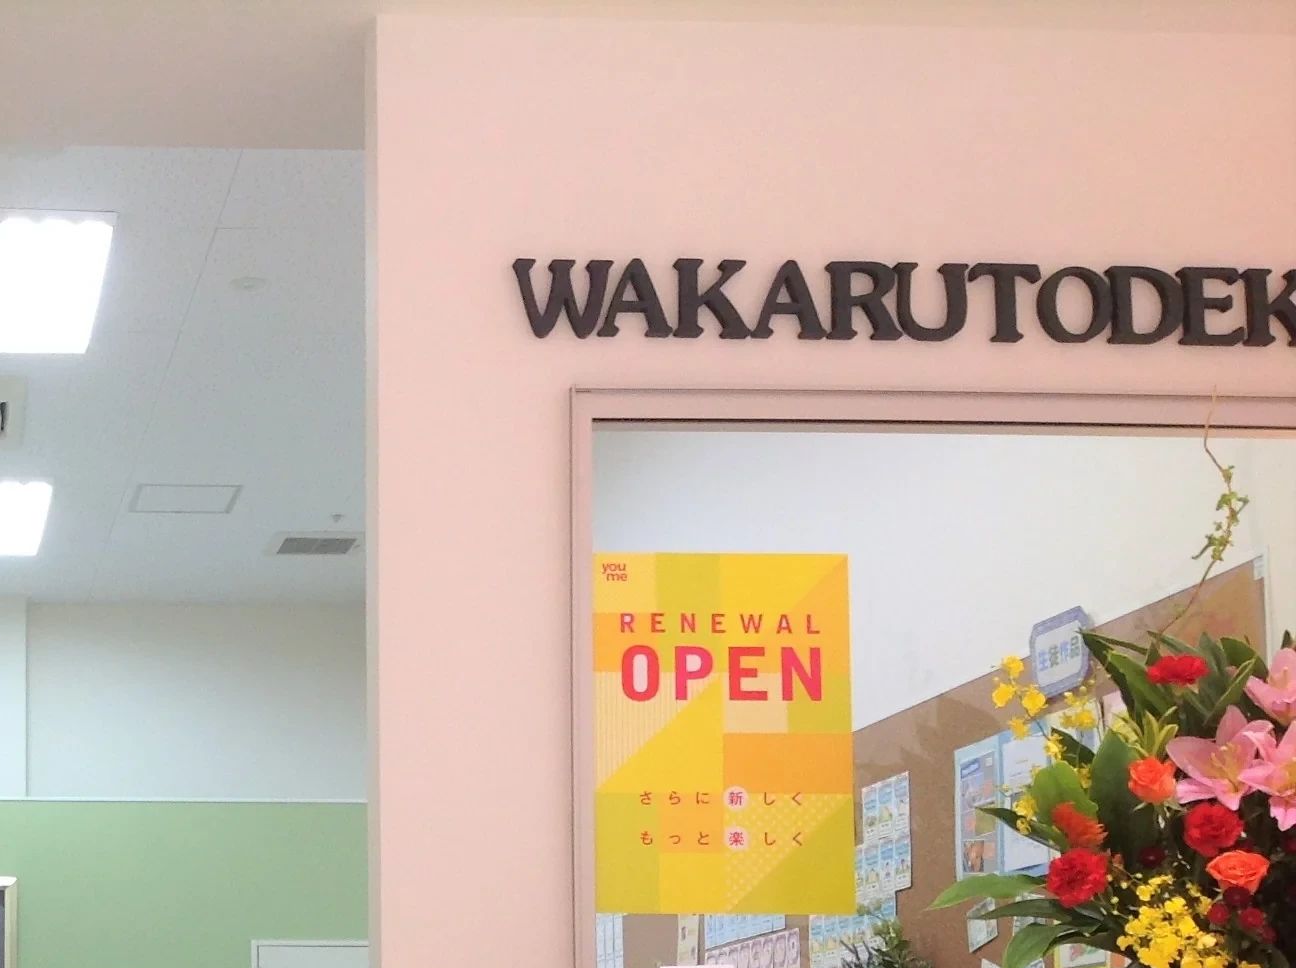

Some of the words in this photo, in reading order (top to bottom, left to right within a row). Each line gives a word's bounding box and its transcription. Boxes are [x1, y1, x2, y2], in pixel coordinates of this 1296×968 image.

[602, 562, 626, 574] you
[606, 572, 628, 582] me
[619, 613, 821, 635] RENEWAL
[621, 644, 823, 703] OPEN
[639, 791, 803, 807] さらに新しく
[640, 831, 804, 847] もっと楽しく
